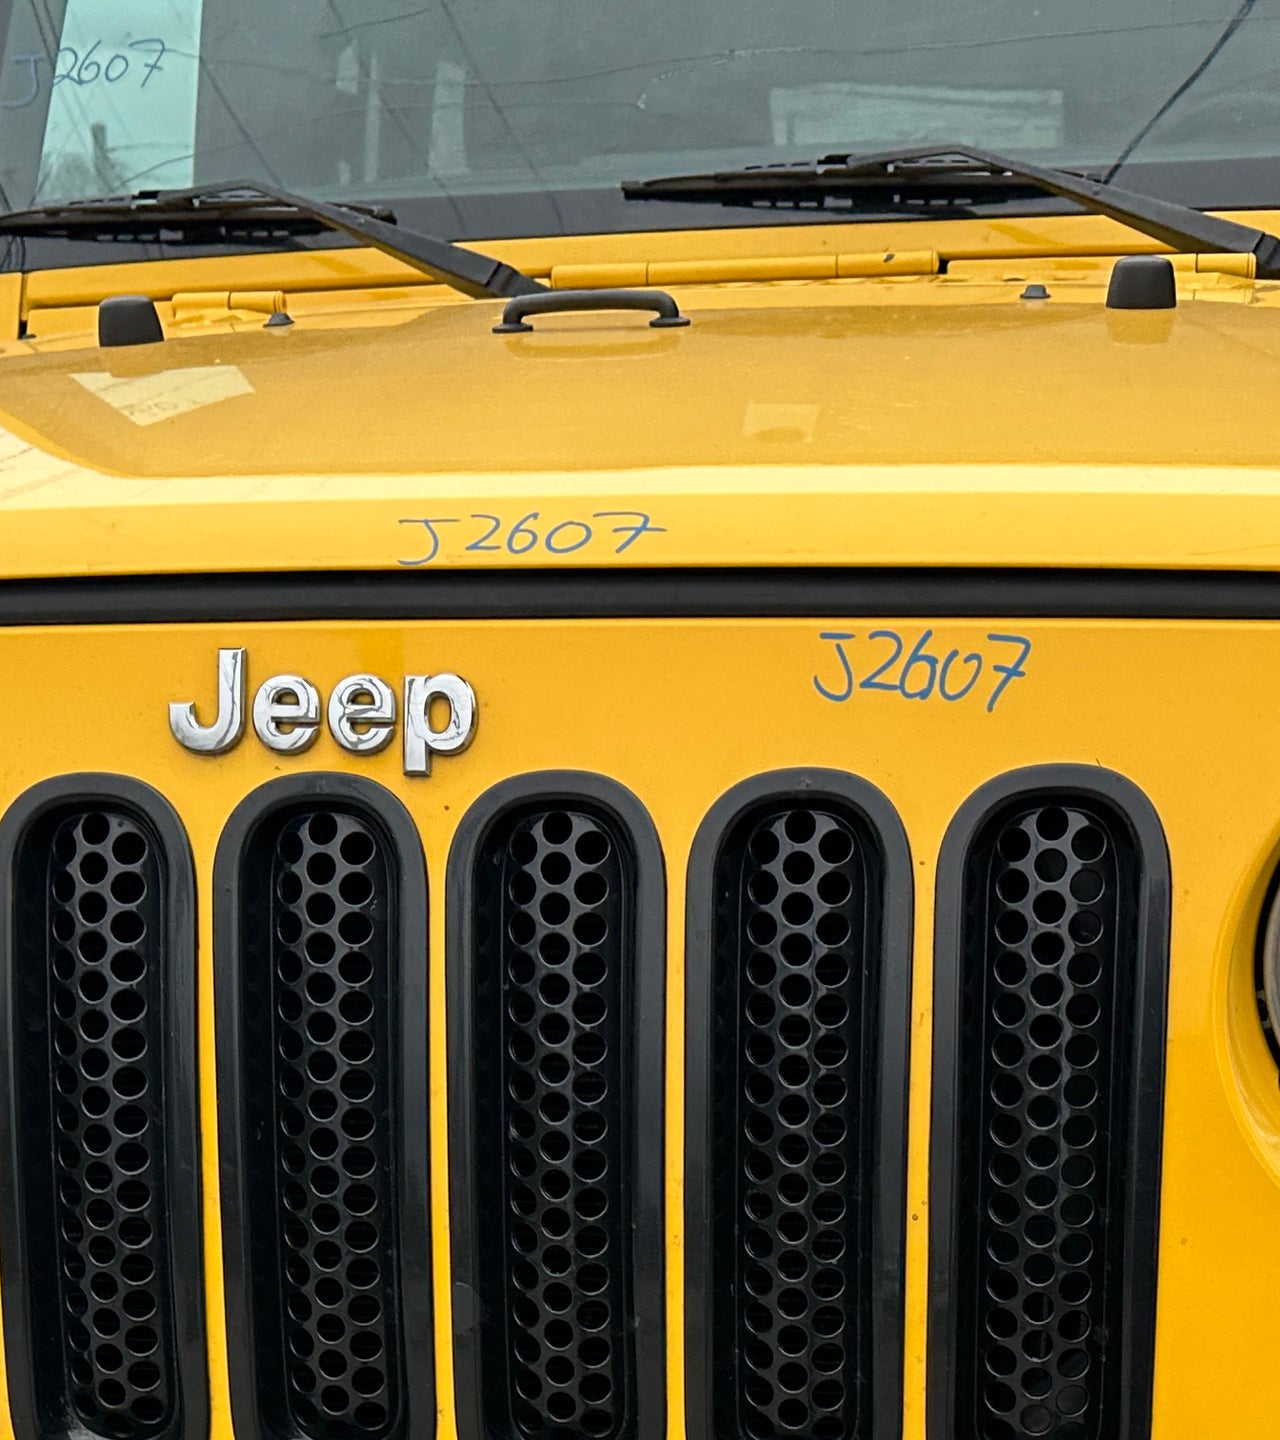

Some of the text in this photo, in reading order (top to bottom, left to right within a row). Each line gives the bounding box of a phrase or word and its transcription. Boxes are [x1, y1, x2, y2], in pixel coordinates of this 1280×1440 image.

[397, 511, 668, 566] J2607
[168, 647, 478, 776] Jeep
[813, 628, 1032, 713] J2607
